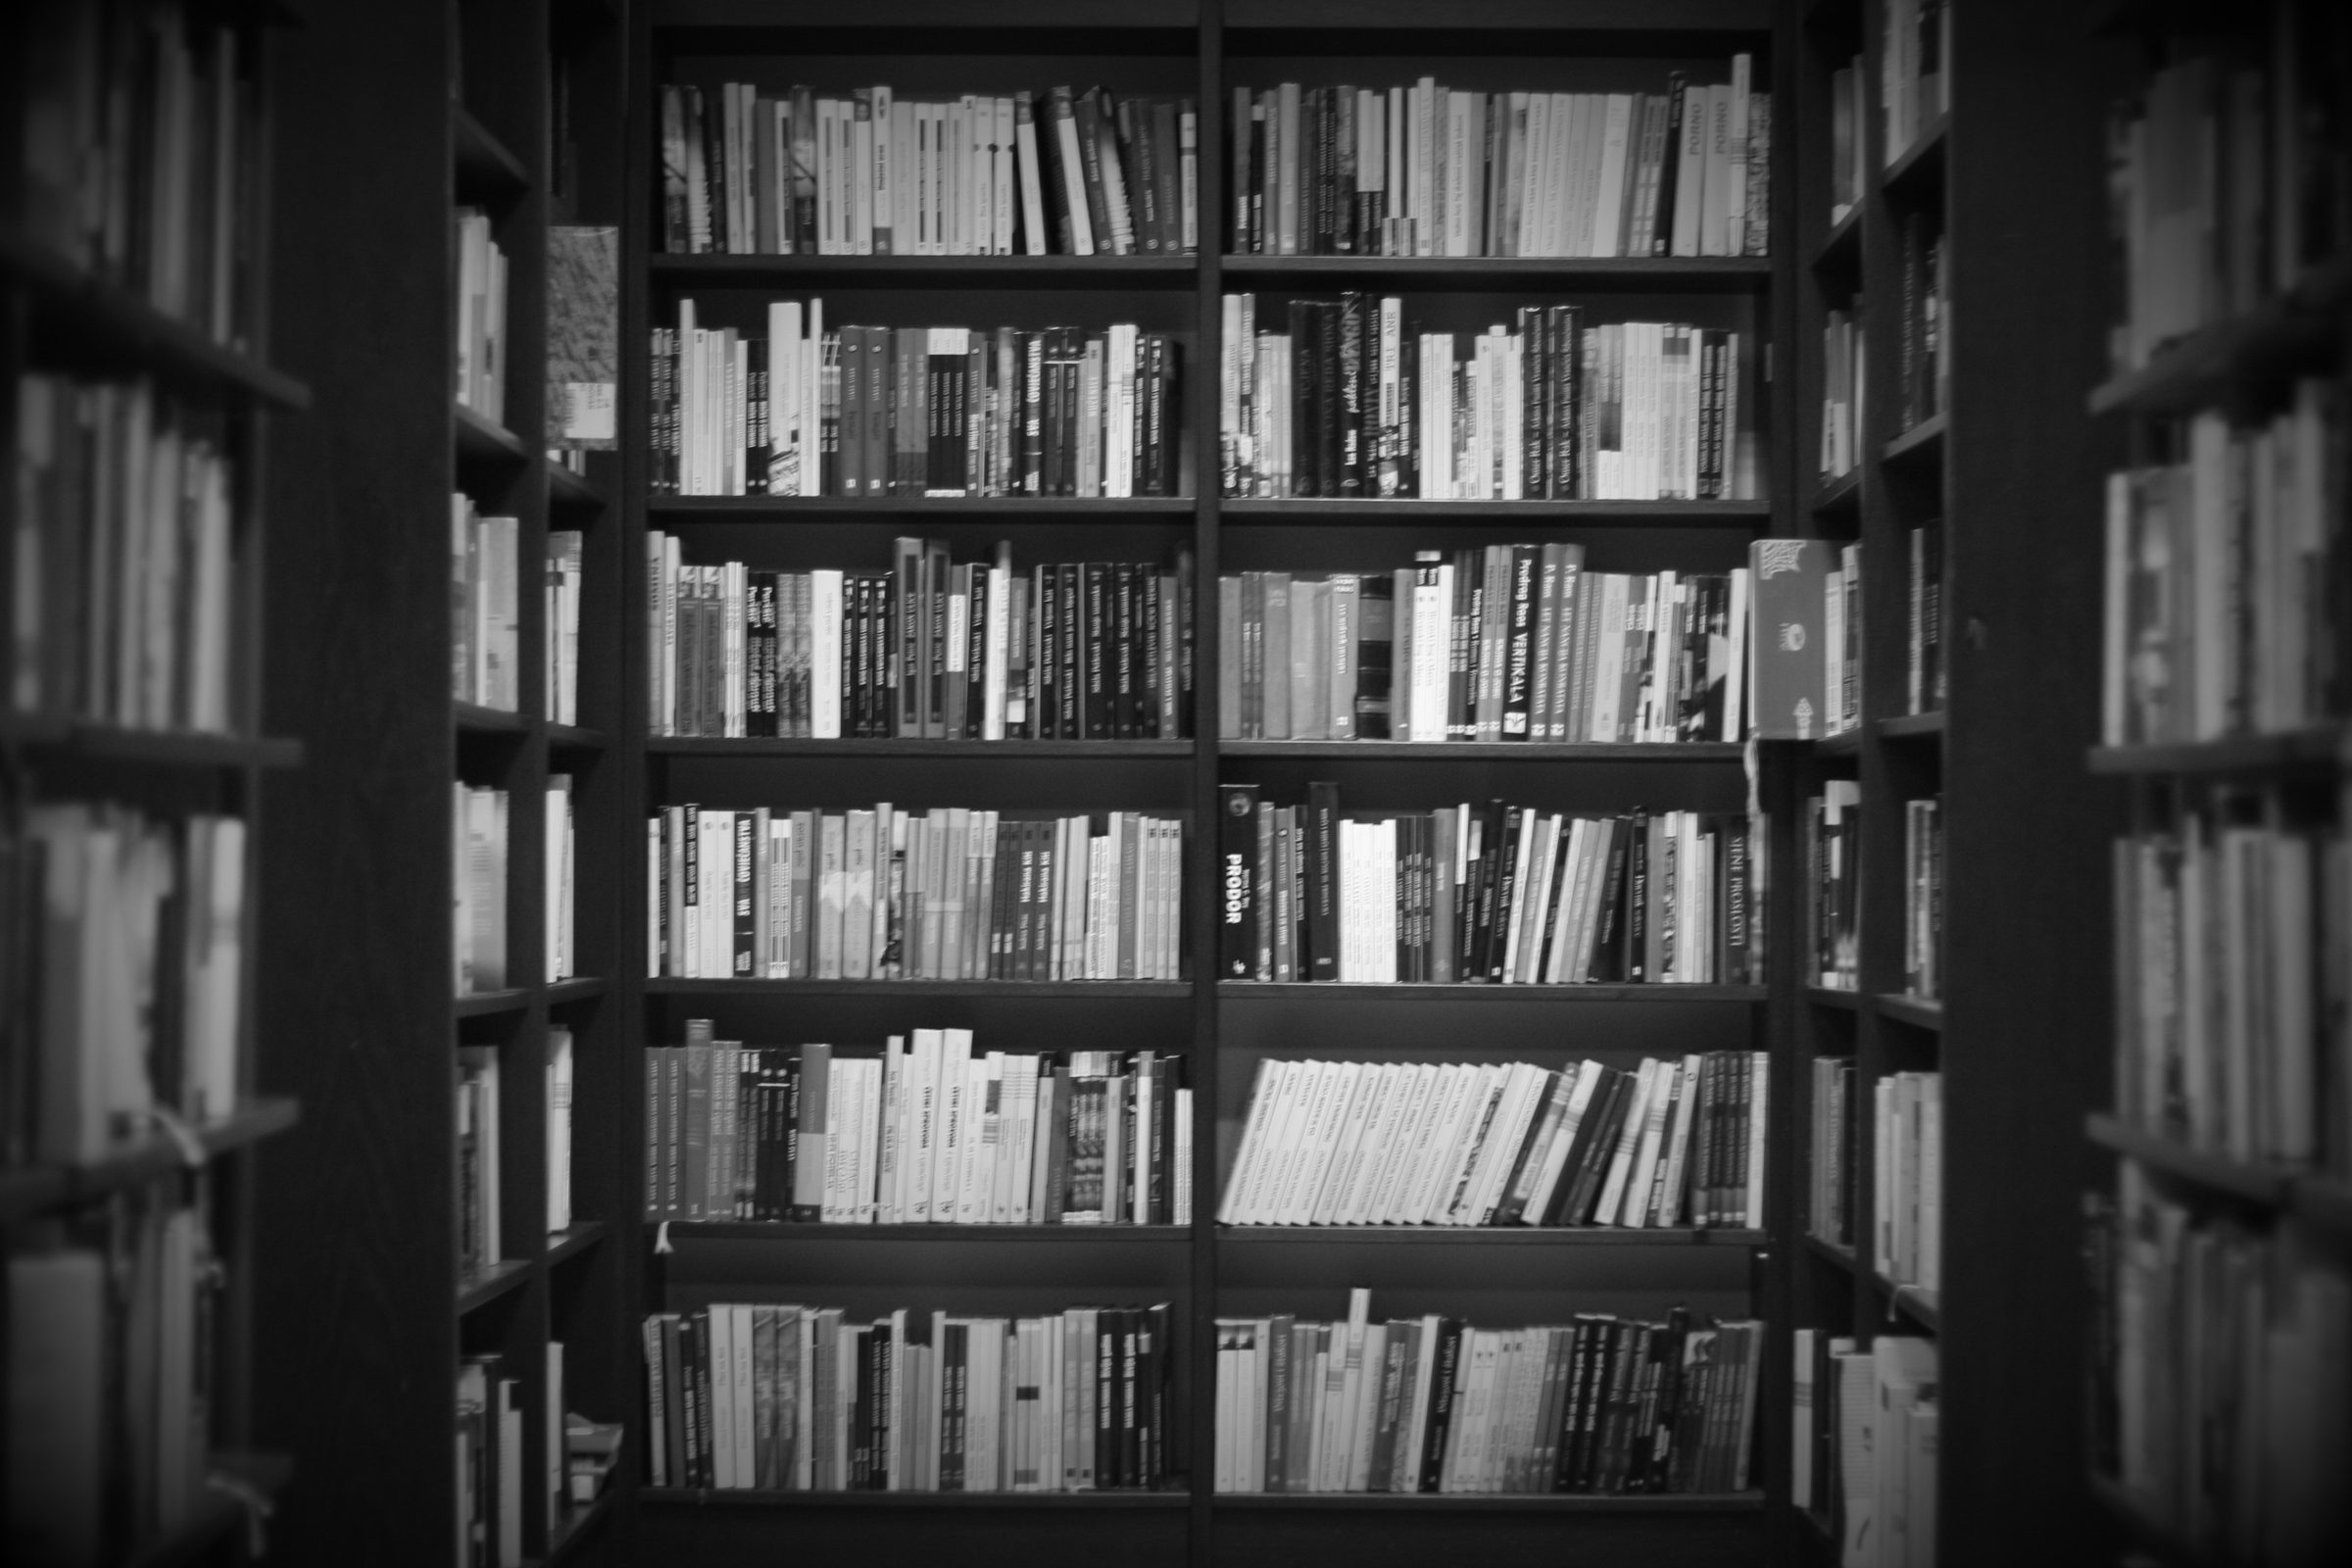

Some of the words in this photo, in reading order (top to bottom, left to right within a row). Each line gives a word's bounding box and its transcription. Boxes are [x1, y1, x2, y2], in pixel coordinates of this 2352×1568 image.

[1690, 103, 1703, 155] PORNO
[1715, 101, 1729, 154] PORNO
[1025, 418, 1040, 437] SVA
[1508, 633, 1529, 703] VERTIKALA
[735, 819, 752, 883] ČOVJEČANSTVA
[1729, 836, 1742, 871] SJENE
[736, 898, 752, 916] SVA
[1225, 854, 1244, 924] PRODOR
